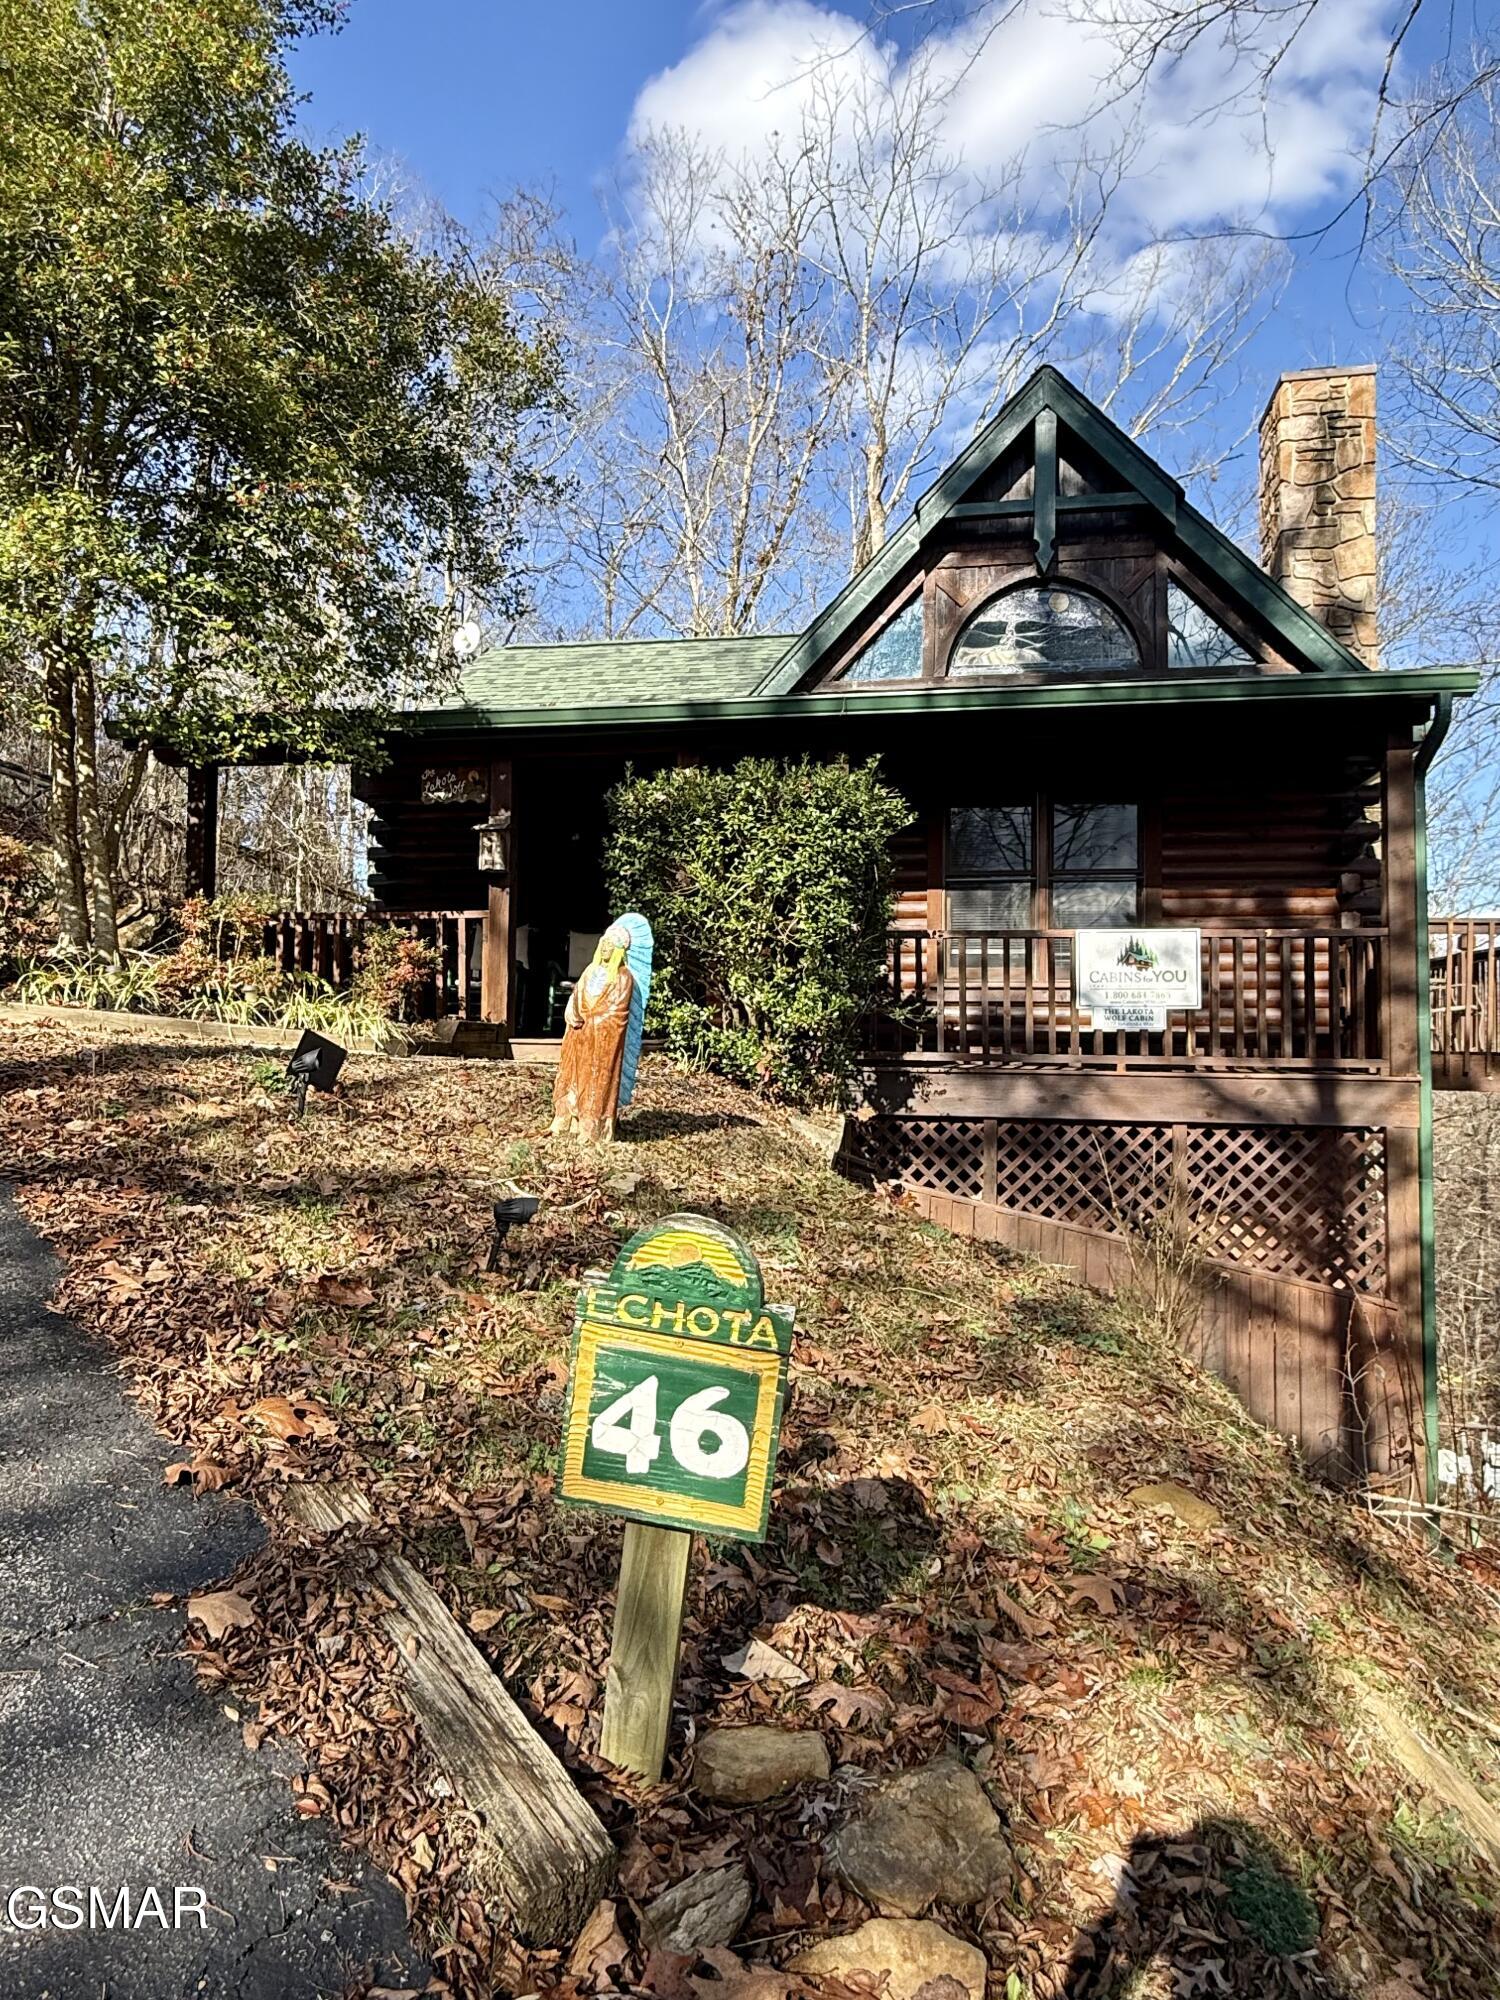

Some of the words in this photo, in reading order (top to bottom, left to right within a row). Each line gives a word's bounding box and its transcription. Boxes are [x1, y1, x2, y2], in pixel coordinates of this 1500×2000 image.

[1089, 970, 1142, 984] CABINS
[1143, 975, 1154, 984] for
[1152, 970, 1187, 983] YOU
[586, 1287, 779, 1350] ECHOTA
[591, 1374, 750, 1479] 46
